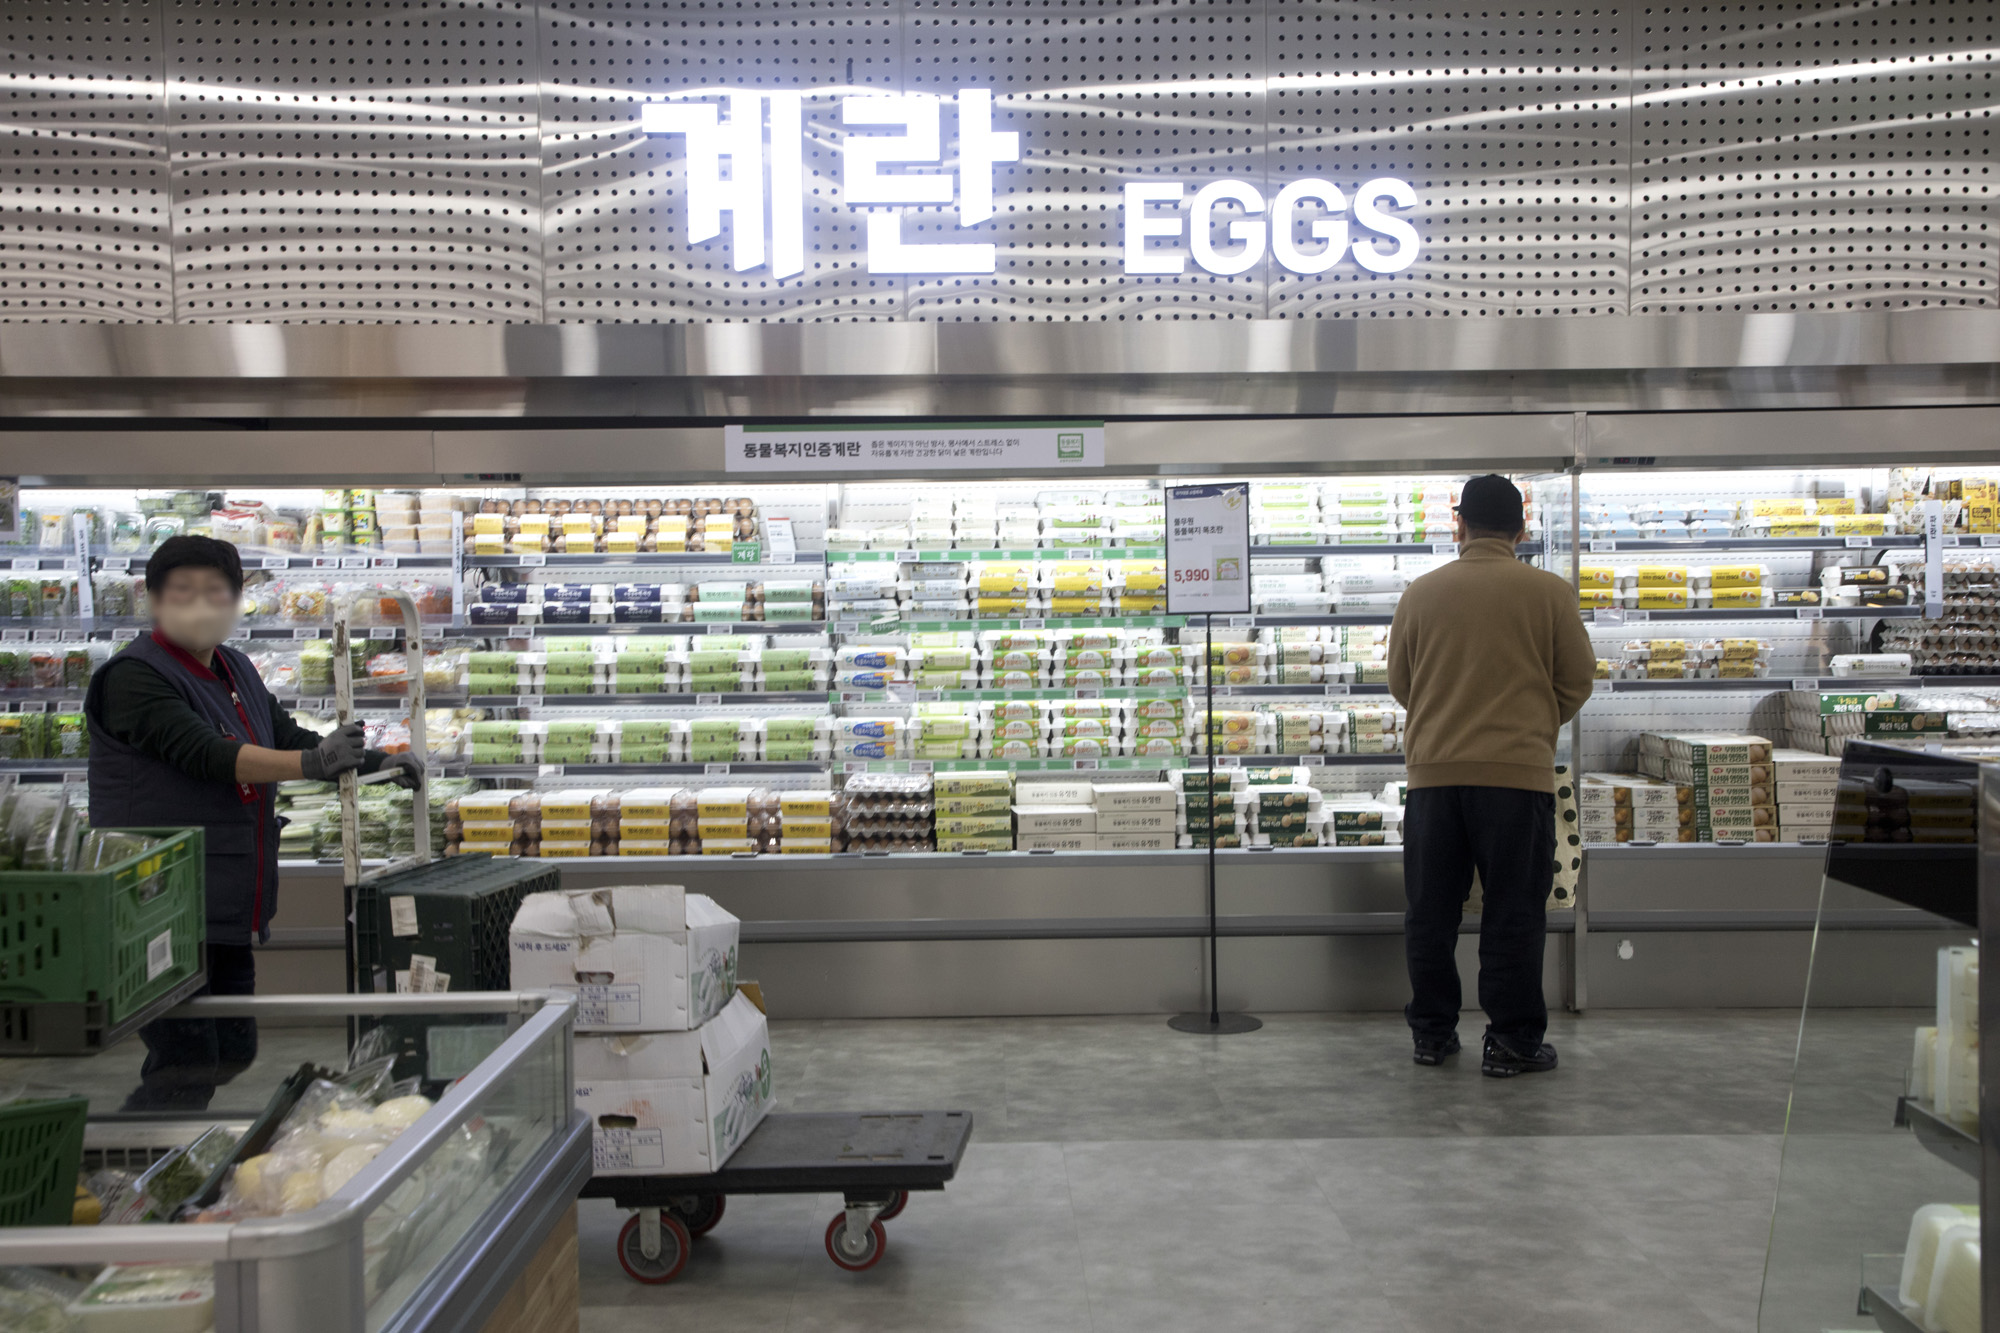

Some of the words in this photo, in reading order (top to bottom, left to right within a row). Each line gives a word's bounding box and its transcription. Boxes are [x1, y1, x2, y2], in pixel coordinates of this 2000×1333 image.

[641, 88, 1019, 280] 계란
[1123, 177, 1421, 275] EGGS
[743, 441, 861, 458] 동물복지인증계란
[977, 439, 1004, 447] 스트레스
[900, 449, 914, 457] 자란
[969, 448, 1003, 456] 계란입니다
[1174, 568, 1209, 584] 5,990
[514, 942, 532, 952] "세척
[535, 943, 542, 951] 후
[544, 942, 571, 952] 드세요"
[576, 1088, 593, 1097] 세요"
